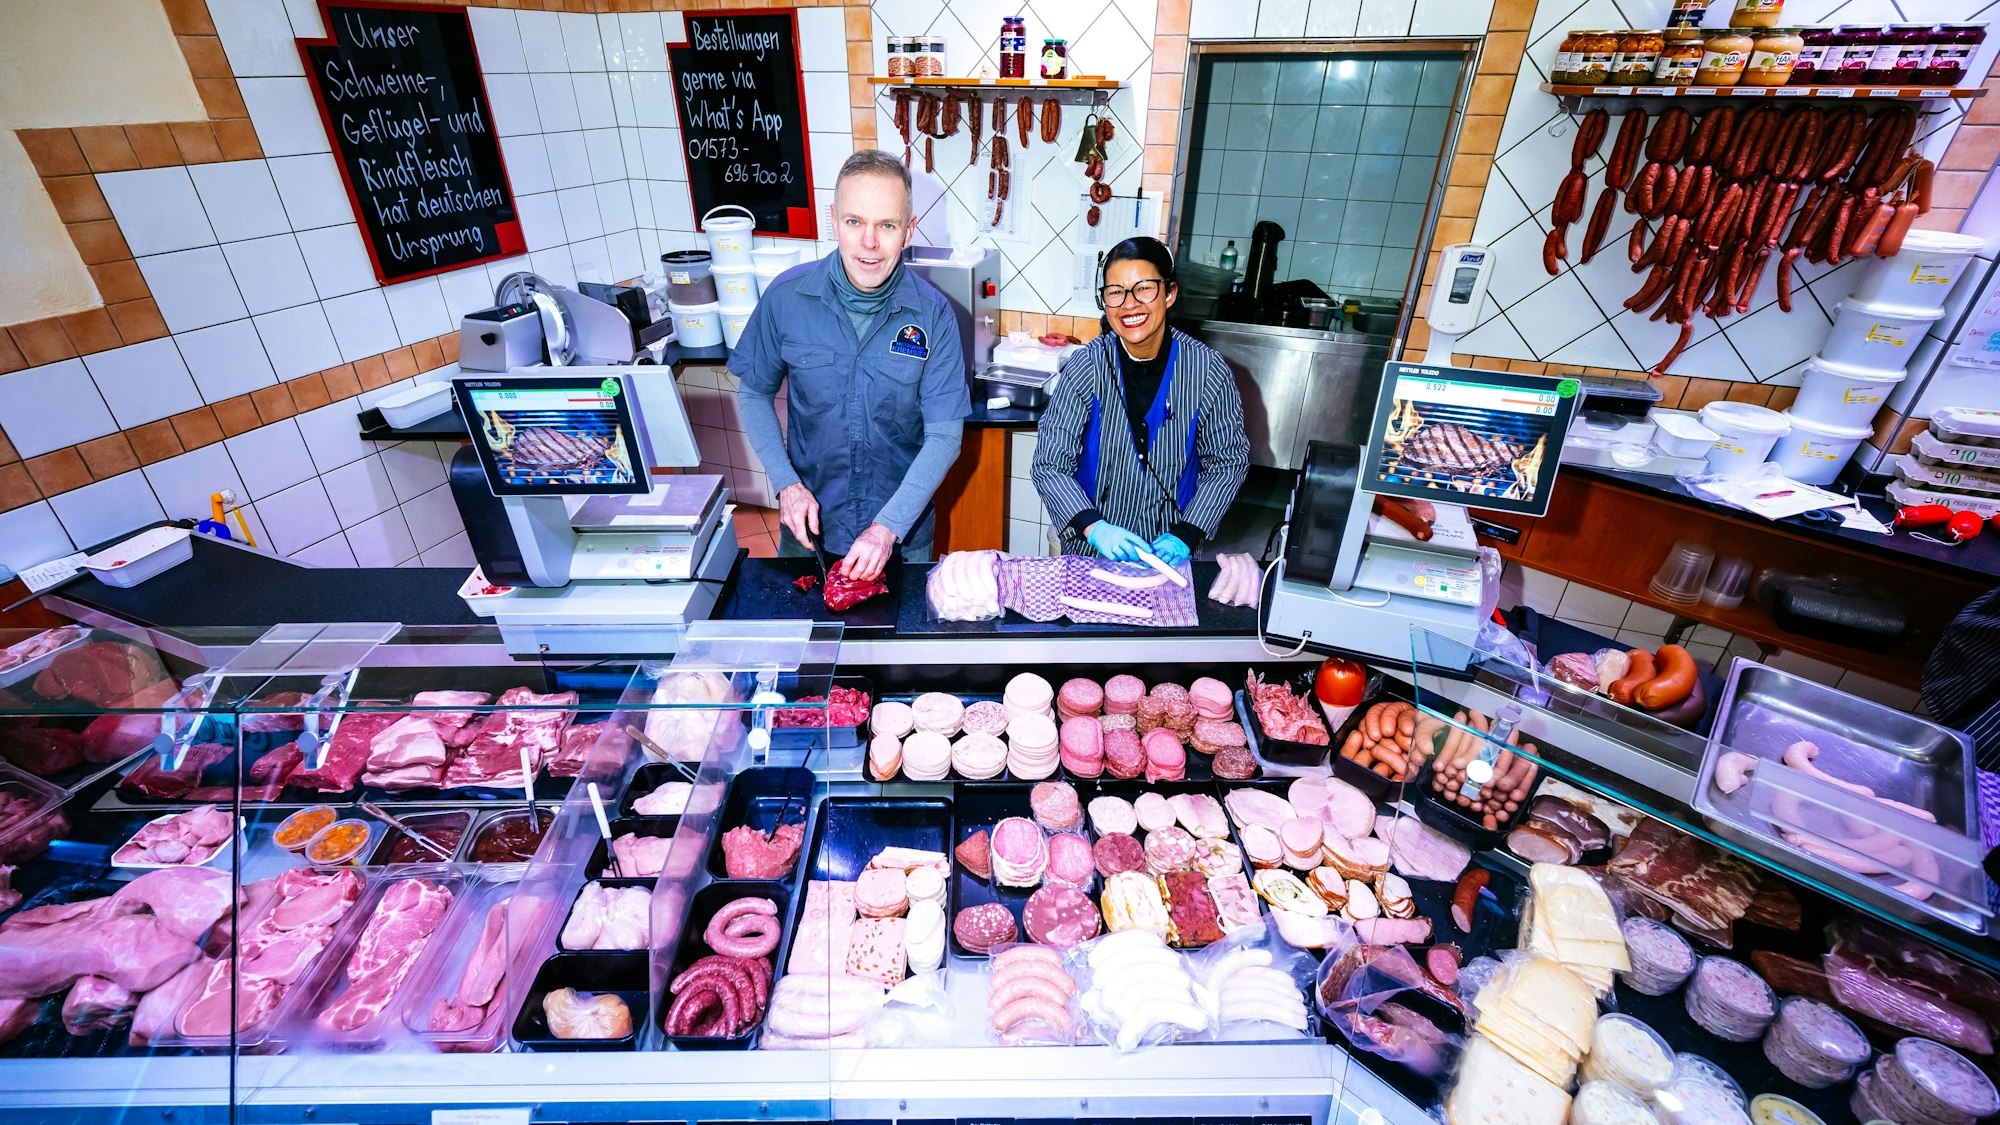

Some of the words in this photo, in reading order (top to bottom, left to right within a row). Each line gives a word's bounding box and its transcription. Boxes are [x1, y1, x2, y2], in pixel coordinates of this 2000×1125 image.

[344, 12, 420, 49] Unser
[692, 19, 780, 62] Bestellungen
[1724, 55, 1741, 63] HAK
[326, 60, 445, 101] Schweine-,
[682, 69, 727, 101] gerne
[731, 62, 756, 90] via
[342, 102, 441, 148] Geflügel-
[447, 97, 486, 133] und
[685, 95, 744, 131] What's
[752, 99, 783, 141] App
[358, 145, 472, 191] Rindfleisch
[373, 191, 411, 227] hat
[417, 180, 503, 219] deutschen
[386, 225, 484, 265] Ursprung
[1426, 383, 1447, 391] 0.522
[1539, 394, 1556, 403] 0.00
[1535, 406, 1553, 414] 0.00
[1960, 449, 1977, 462] 10
[1944, 472, 1961, 485] 10
